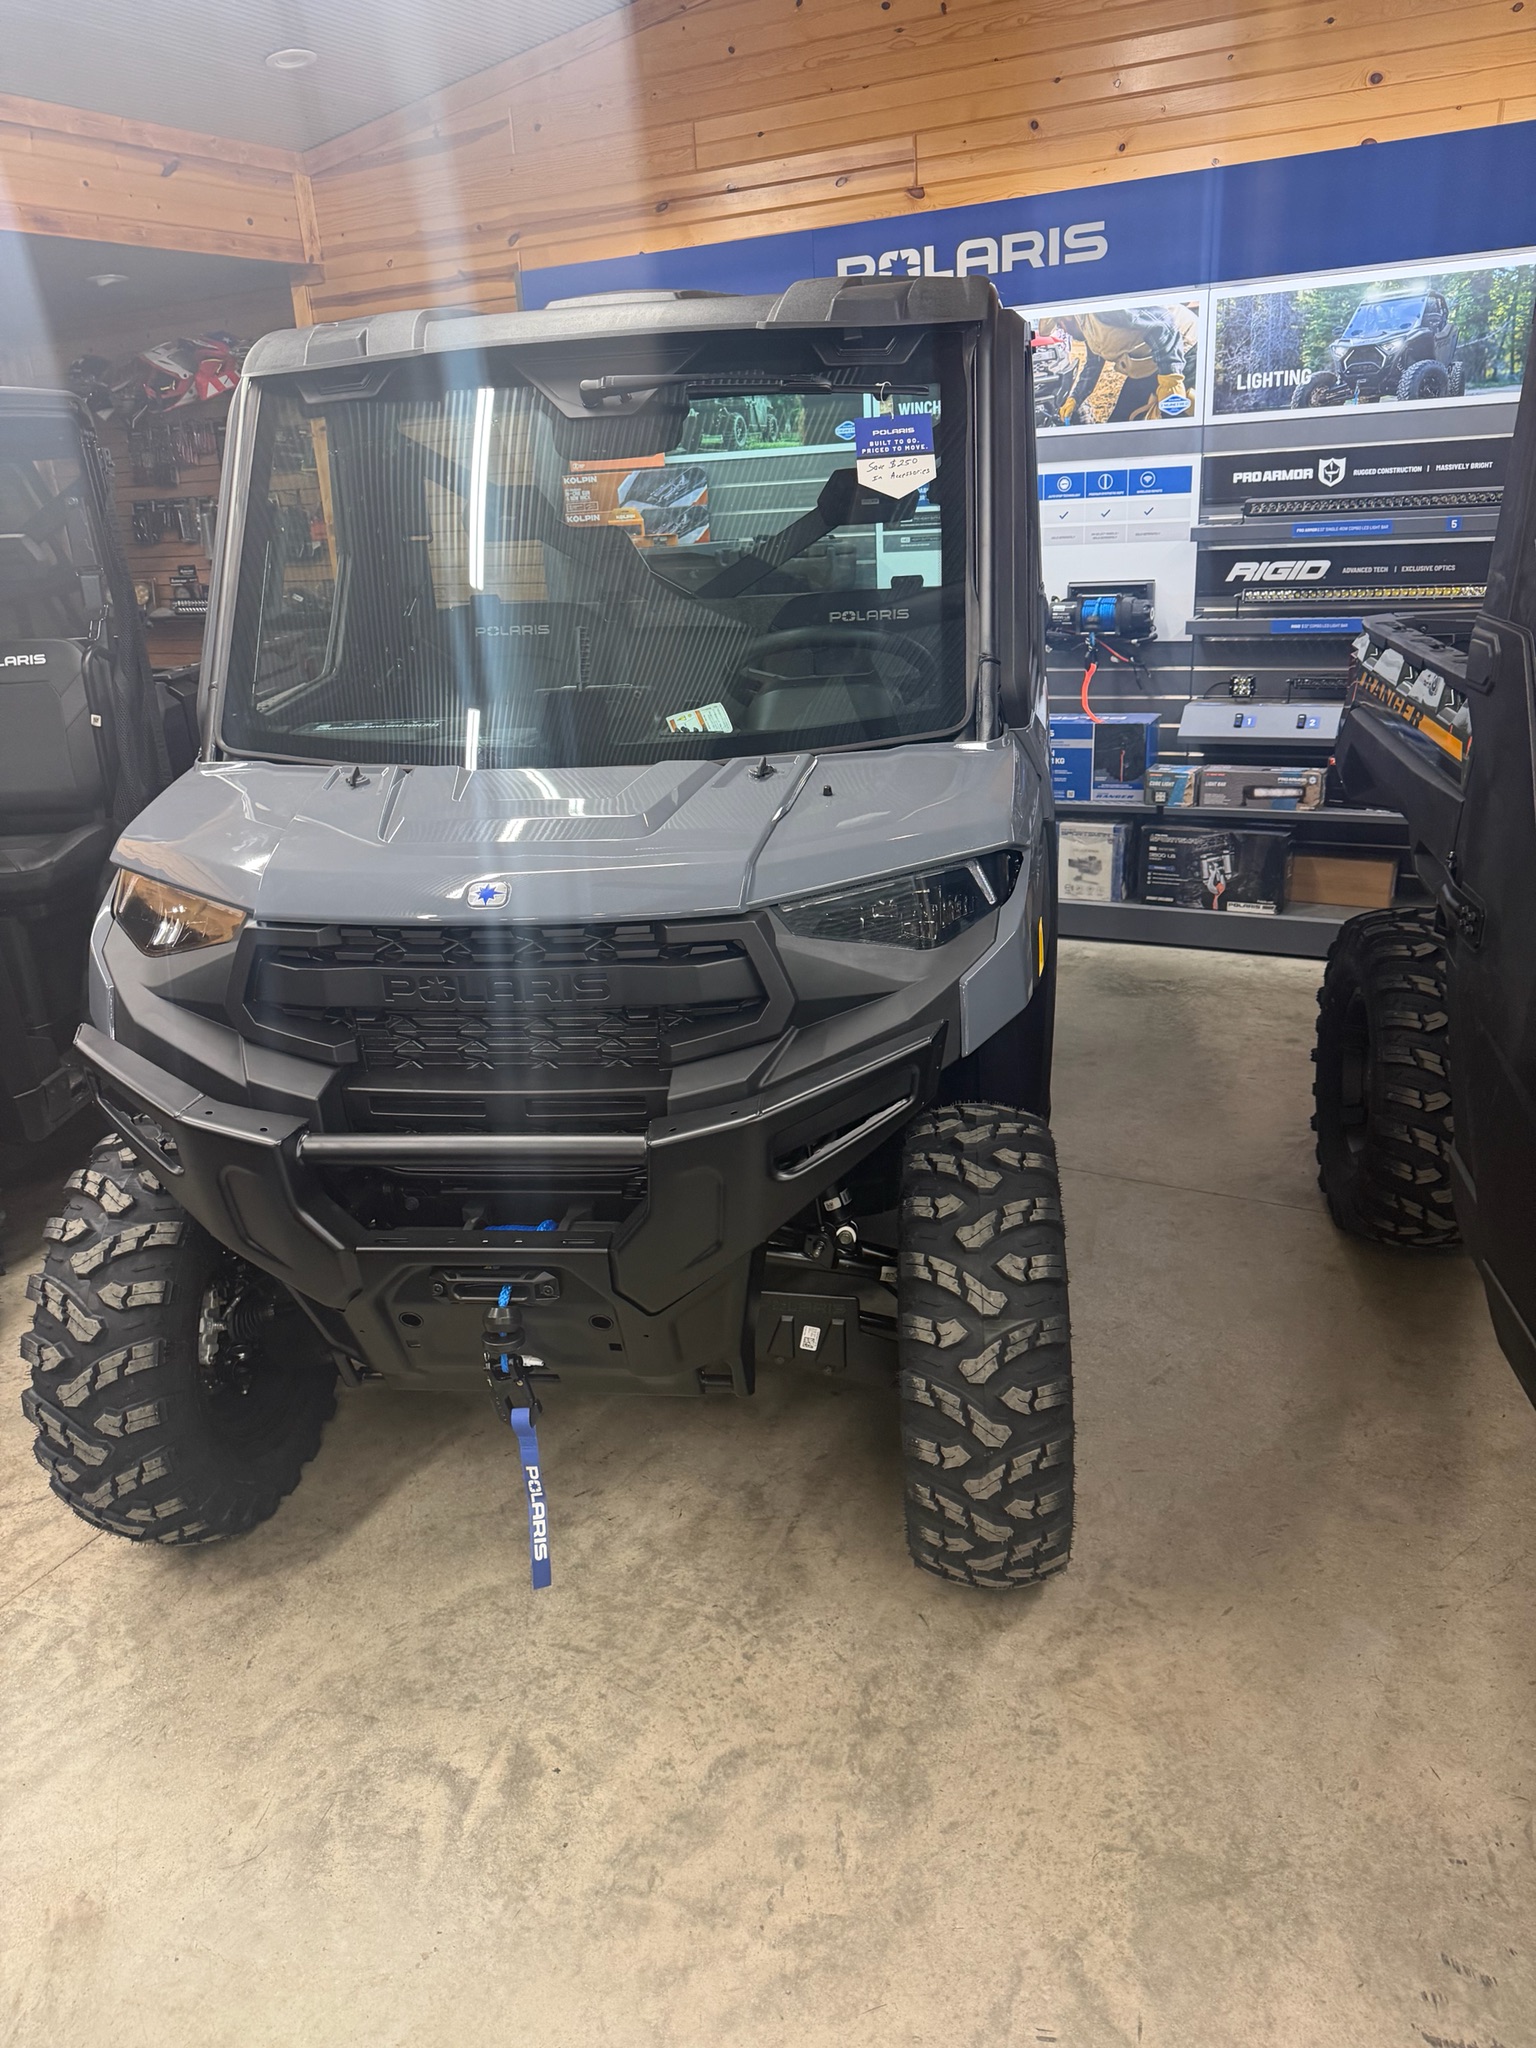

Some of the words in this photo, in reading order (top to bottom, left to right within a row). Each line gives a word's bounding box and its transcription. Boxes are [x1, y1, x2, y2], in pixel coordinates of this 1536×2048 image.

[837, 220, 1109, 278] POLARIS
[1236, 368, 1312, 391] LIGHTING
[898, 400, 941, 416] WINCH
[872, 427, 915, 436] POLARIS
[866, 461, 885, 473] Save
[888, 458, 918, 469] $250
[1352, 468, 1377, 476] RUGGED
[1377, 465, 1423, 475] CONSTRUCTION
[1435, 462, 1470, 471] MASSIVELY
[1470, 461, 1494, 470] BRIGHT
[563, 476, 597, 484] KOLPIN
[566, 514, 600, 523] KOLPIN
[1224, 559, 1332, 582] RIGID
[1342, 566, 1373, 574] ADVANCED
[1433, 564, 1456, 572] OPTICS
[829, 608, 910, 623] POLARIS
[474, 624, 551, 638] POLARIS
[1246, 717, 1252, 726] 1
[1308, 718, 1316, 727] 2
[381, 972, 611, 1004] POLARIS
[525, 1465, 548, 1562] POLARIS
